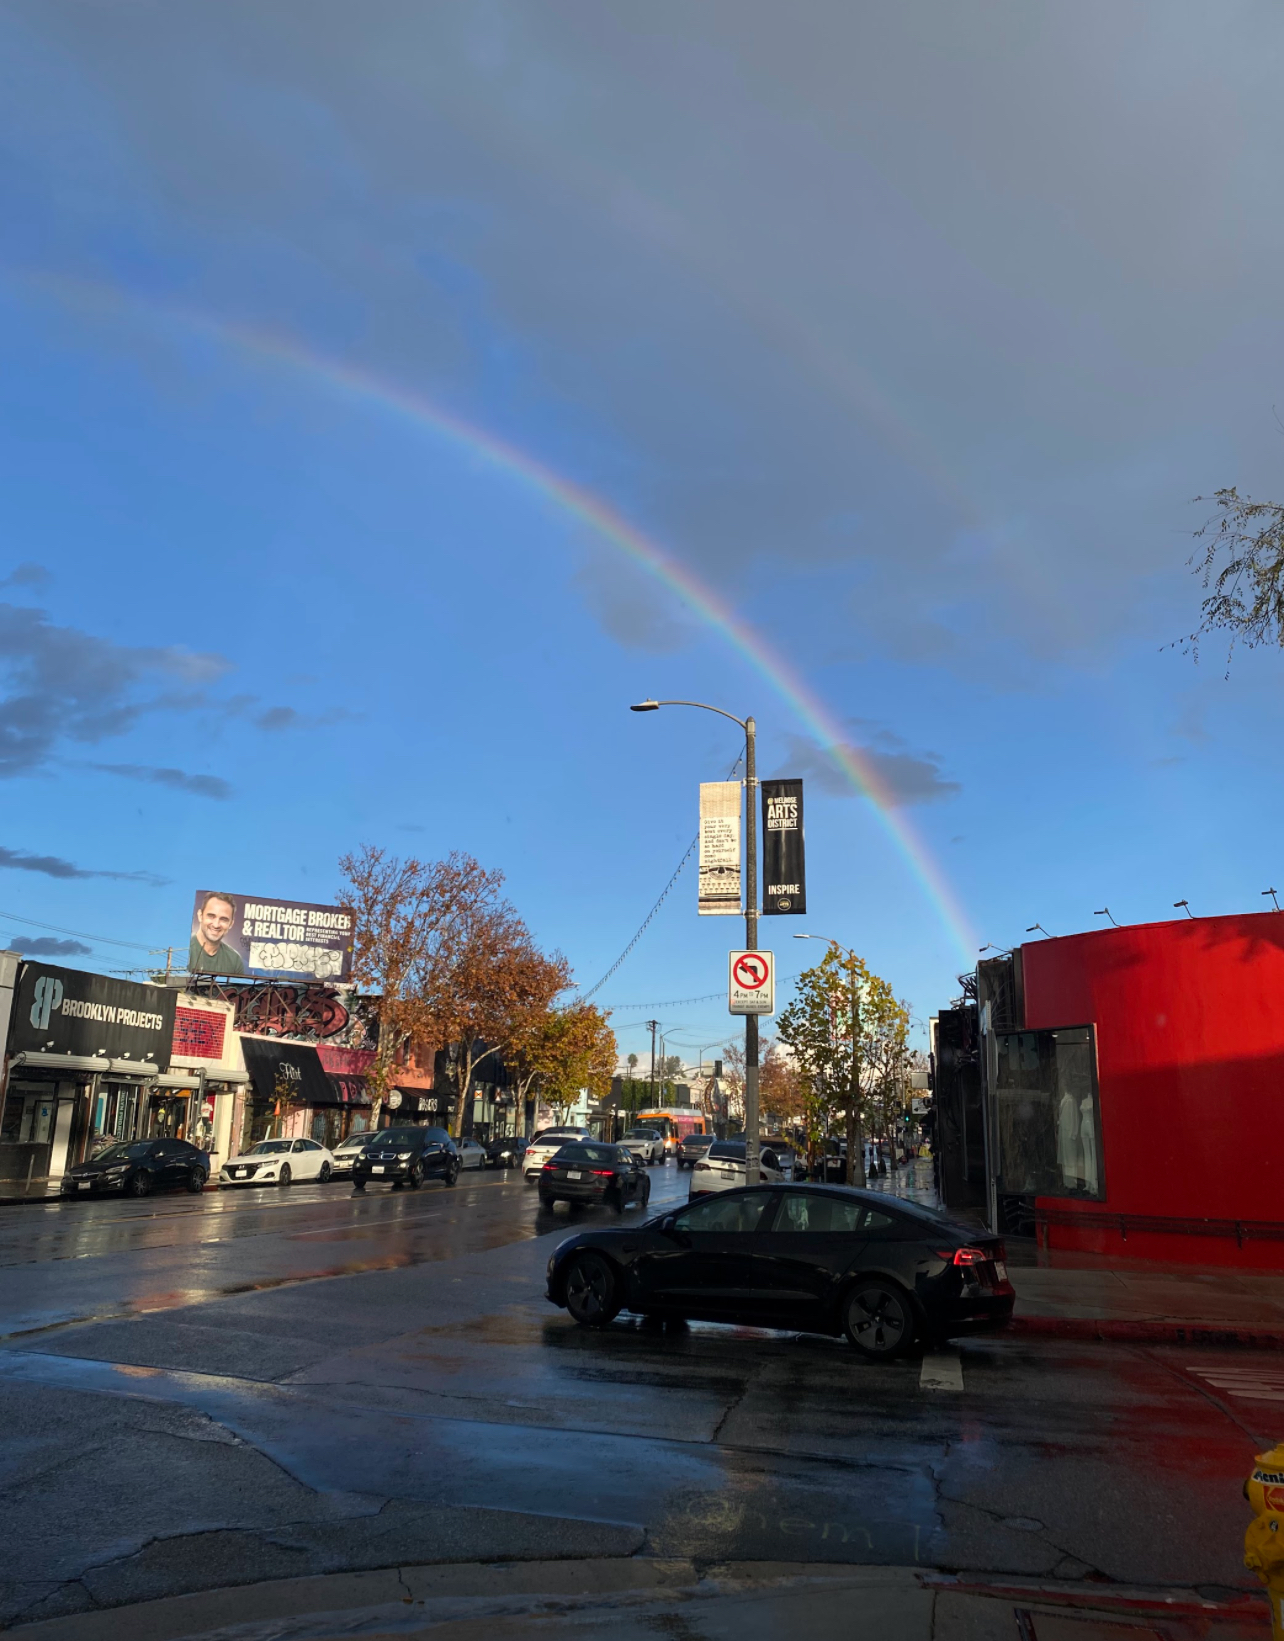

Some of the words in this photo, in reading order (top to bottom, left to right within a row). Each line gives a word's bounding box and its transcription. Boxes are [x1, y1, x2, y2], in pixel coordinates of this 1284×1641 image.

[774, 796, 797, 804] MELROSE
[767, 803, 798, 818] ARTS
[767, 818, 798, 828] DISTRICT
[768, 884, 801, 895] INSPIRE
[243, 902, 308, 926] MORTGAGE
[307, 910, 352, 930] BROKER
[242, 920, 253, 936] &
[254, 921, 305, 941] REALTOR
[61, 998, 117, 1024] BROOKLYN
[116, 1007, 163, 1031] PROJECTS
